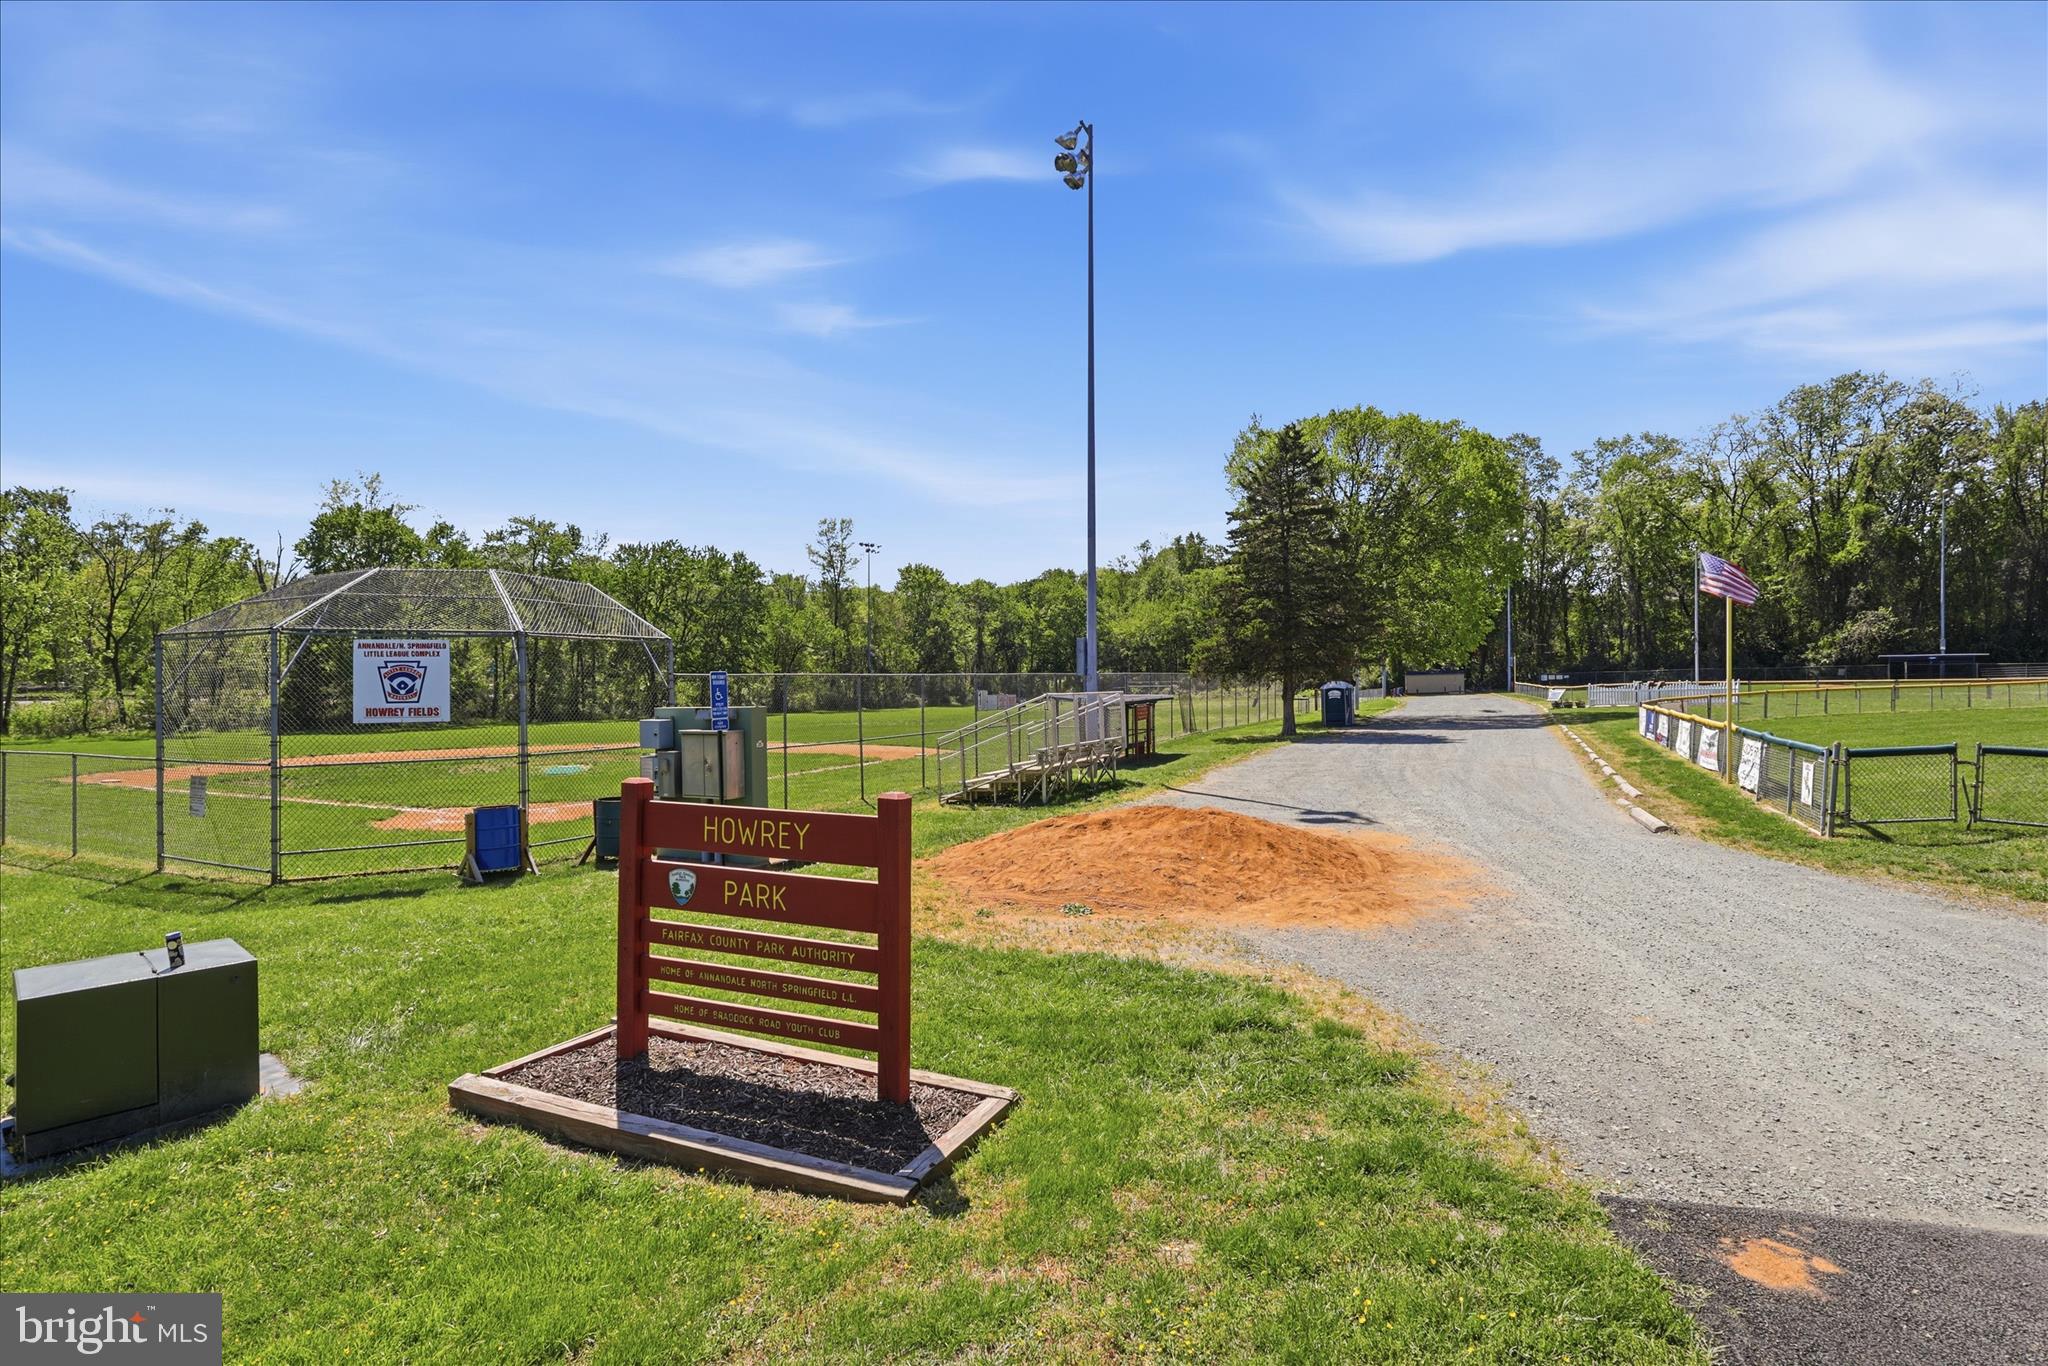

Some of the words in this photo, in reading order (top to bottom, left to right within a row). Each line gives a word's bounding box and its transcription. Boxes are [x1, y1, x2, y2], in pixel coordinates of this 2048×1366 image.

[407, 642, 447, 650] SPRINGFIELD
[365, 707, 405, 717] HOWREY
[408, 707, 440, 717] FIELDS
[703, 815, 812, 851] HOWREY
[723, 879, 787, 912] PARK
[662, 928, 704, 944] FAIRFAX
[709, 934, 751, 950] COUNTY
[756, 940, 785, 955] PARK
[791, 946, 856, 965] AUTHORITY
[660, 966, 681, 977] HOME
[684, 969, 694, 979] OF
[699, 971, 746, 987] ANNANDALE
[750, 978, 778, 991] NORTH
[782, 983, 838, 1000] SPRINGFIELD
[841, 992, 857, 1003] L.L.
[673, 1004, 695, 1016] HOME
[699, 1008, 709, 1017] OF
[712, 1010, 754, 1025] BRADDOCK
[758, 1017, 781, 1030] ROAD
[786, 1022, 814, 1035] YOUTH
[818, 1027, 841, 1039] CLUB
